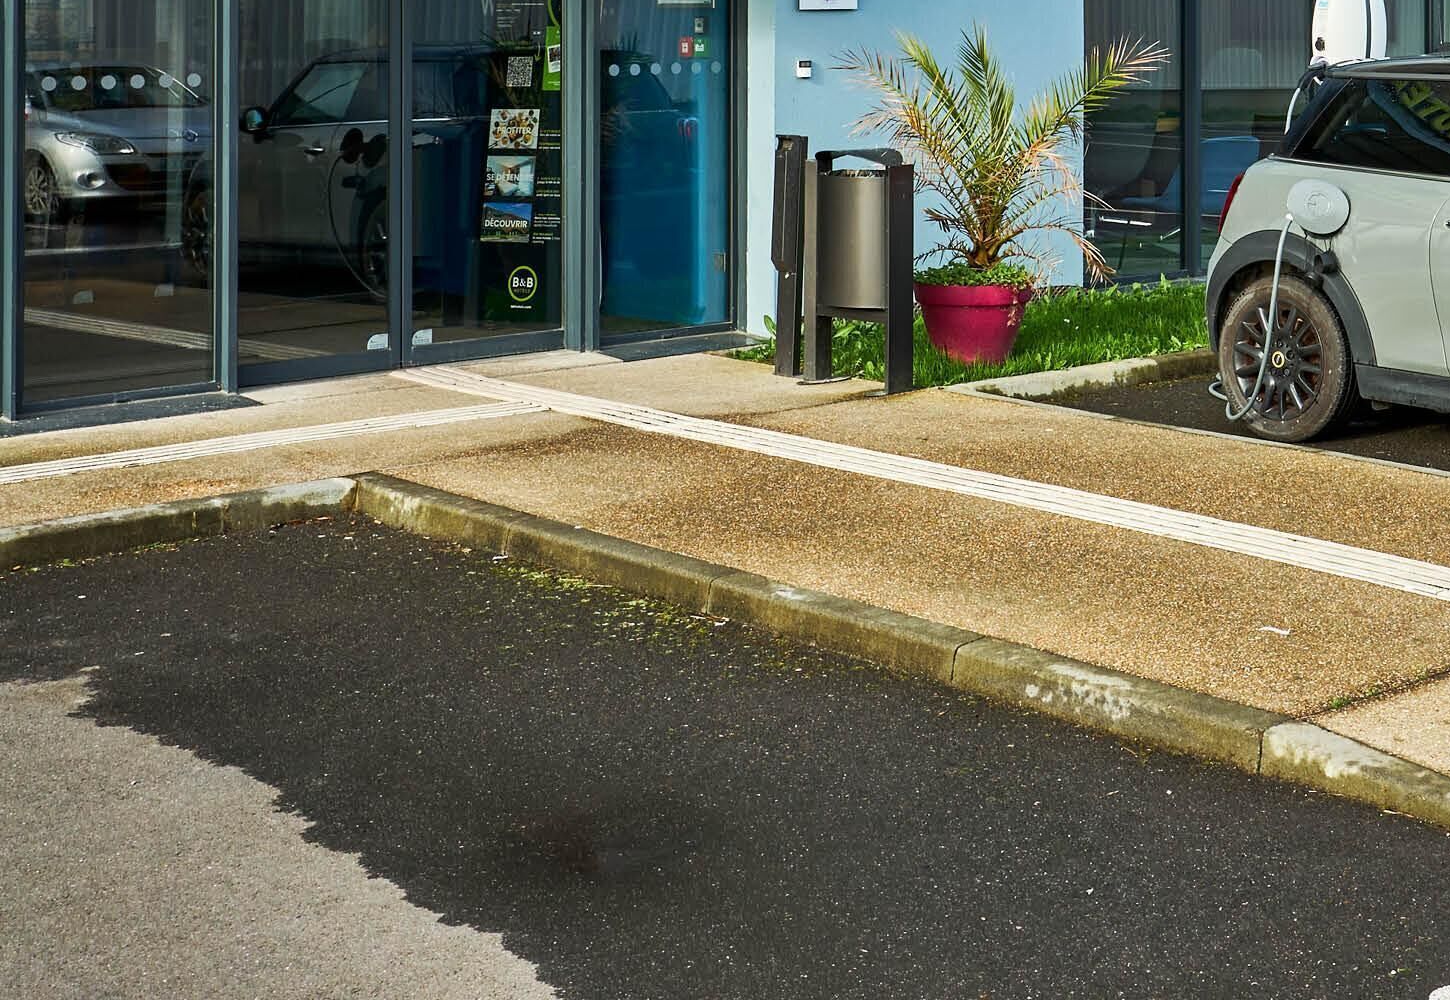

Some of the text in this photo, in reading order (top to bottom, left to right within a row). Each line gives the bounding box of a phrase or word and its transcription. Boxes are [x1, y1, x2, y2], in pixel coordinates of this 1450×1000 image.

[486, 173, 496, 181] SE
[484, 217, 528, 228] DÉCOUVRIR
[512, 276, 534, 288] B&B
